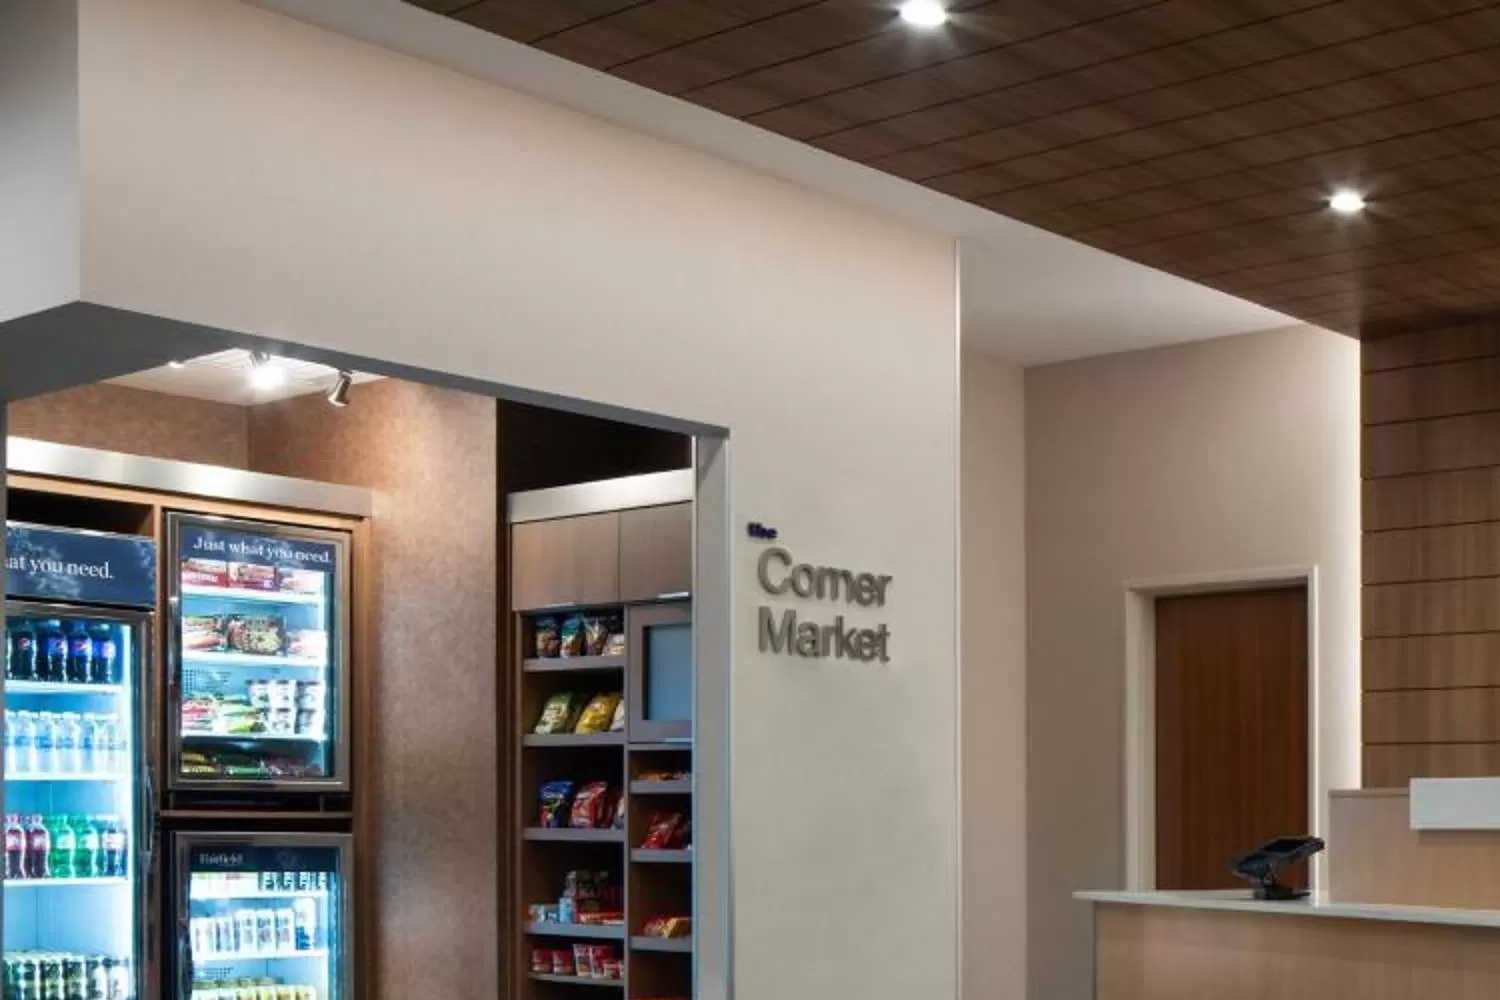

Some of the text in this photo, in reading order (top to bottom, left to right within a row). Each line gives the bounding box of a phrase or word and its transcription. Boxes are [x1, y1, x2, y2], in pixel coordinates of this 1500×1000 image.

[29, 557, 63, 575] you
[64, 561, 115, 579] need.
[193, 536, 225, 551] Just
[229, 540, 264, 556] what
[266, 544, 293, 561] you
[757, 547, 893, 607] Corner
[757, 605, 891, 663] Market
